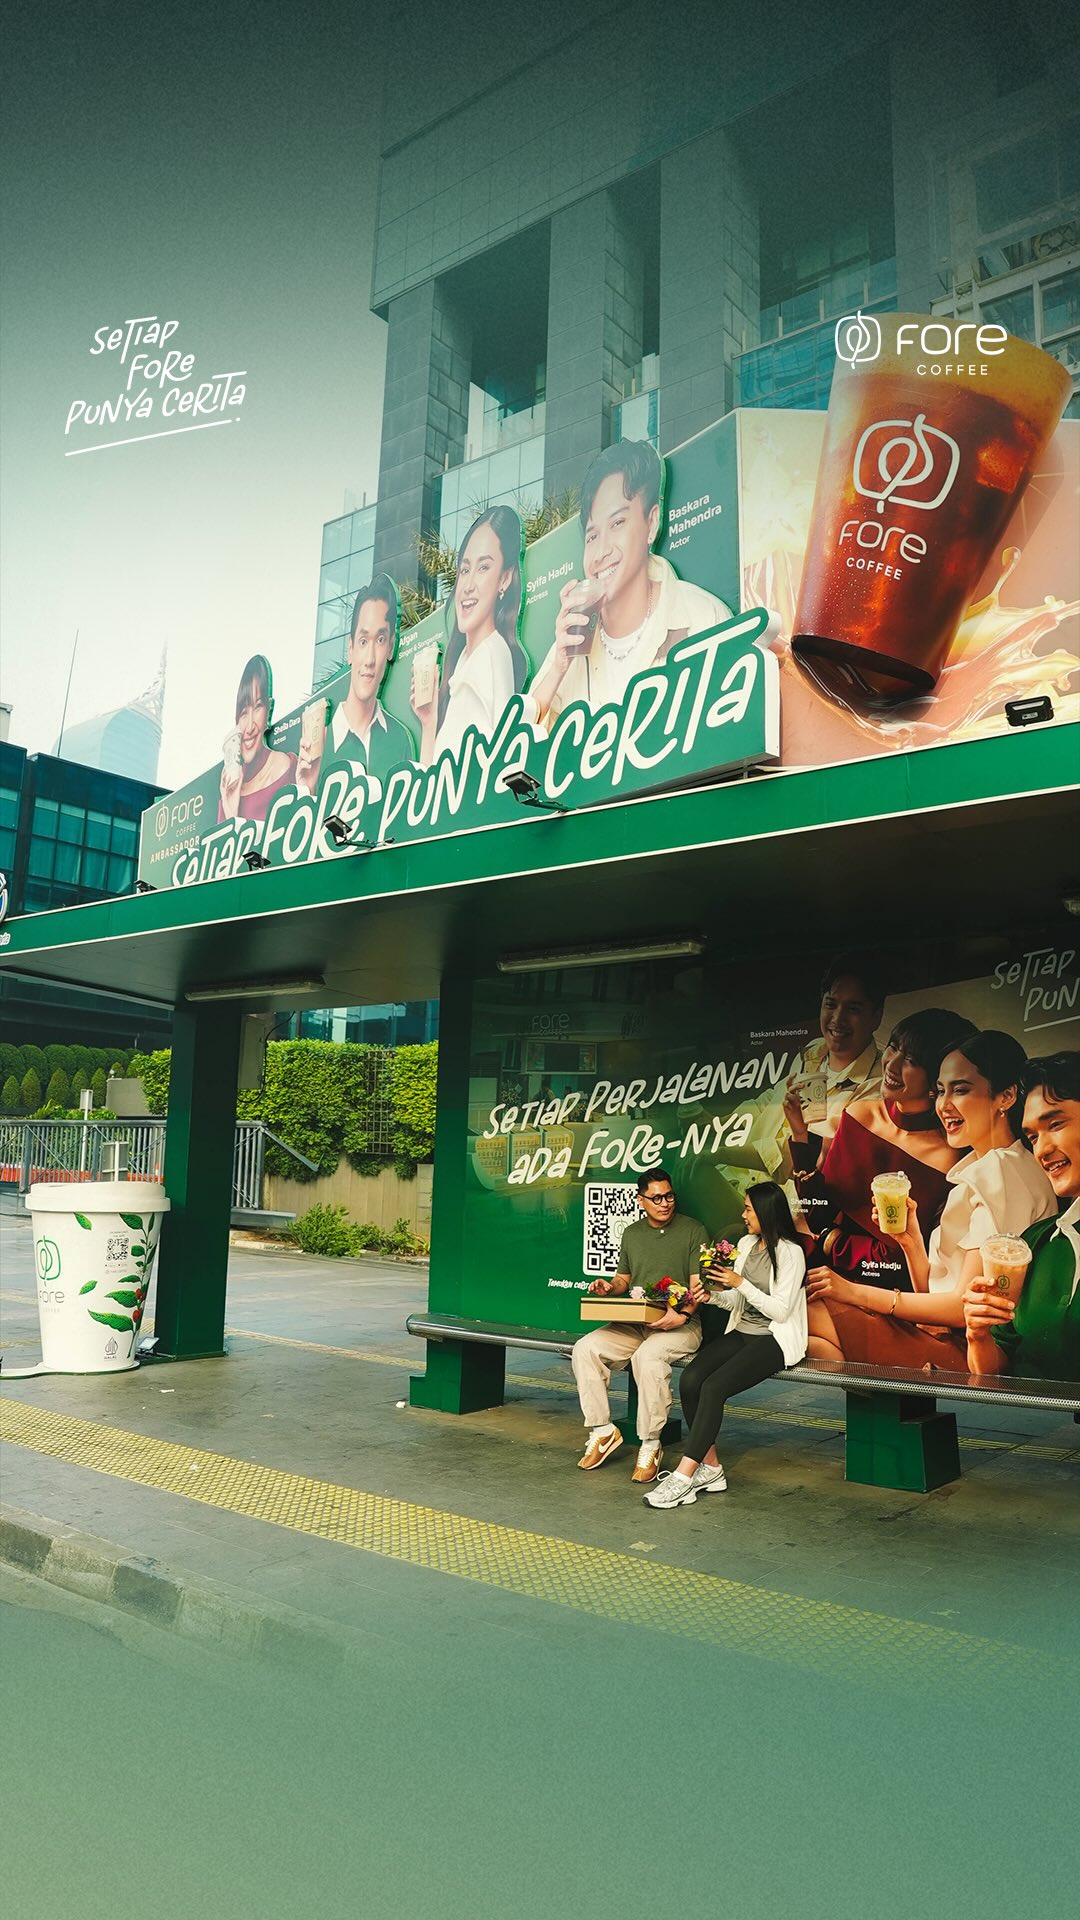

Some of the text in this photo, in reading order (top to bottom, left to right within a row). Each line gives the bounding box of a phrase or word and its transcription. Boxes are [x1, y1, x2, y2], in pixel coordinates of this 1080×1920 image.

[668, 494, 710, 521] Baskara
[668, 505, 722, 537] Mahendra
[669, 536, 691, 551] Actor
[846, 557, 903, 580] COFFEE
[526, 561, 574, 593] Syifa Hadju
[526, 590, 549, 605] Actress
[399, 631, 418, 648] Afgan
[175, 822, 197, 838] COFFEE
[150, 835, 201, 865] AMBASSADOR
[750, 1028, 809, 1039] Baskara Mahendra
[812, 1198, 829, 1206] Dara
[861, 1260, 902, 1271] Syifa Hadju
[861, 1270, 881, 1278] Actress
